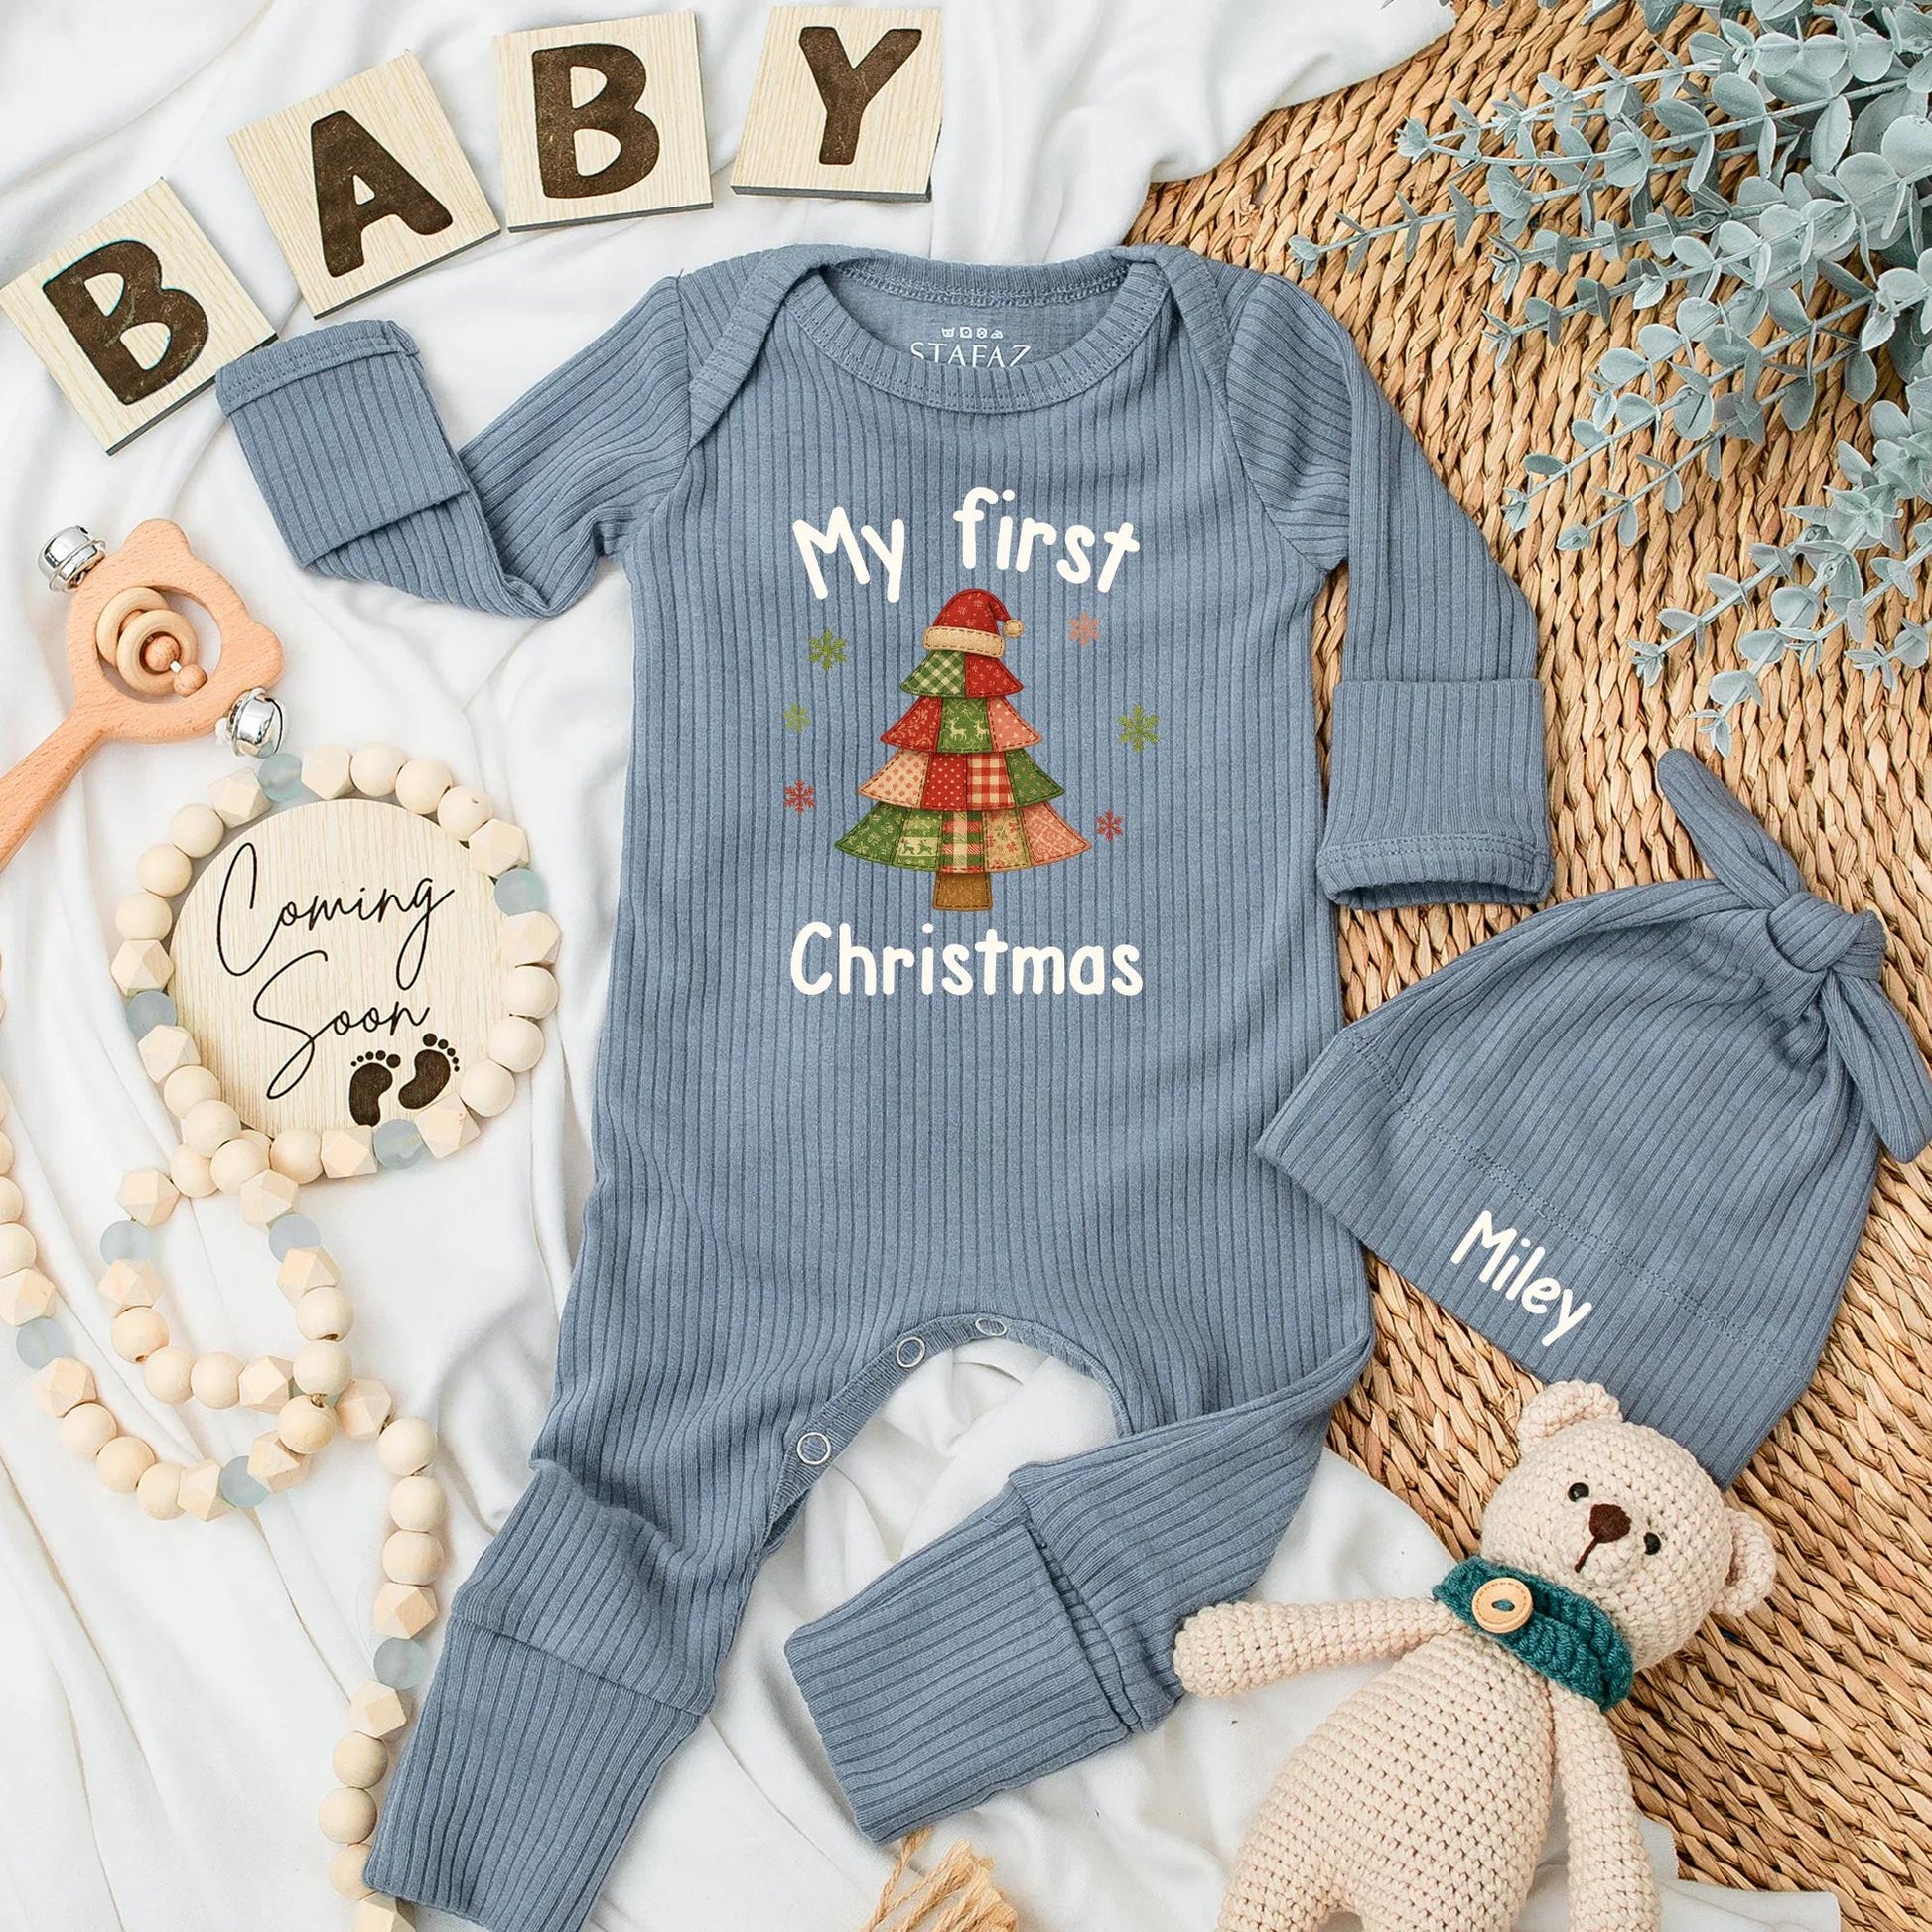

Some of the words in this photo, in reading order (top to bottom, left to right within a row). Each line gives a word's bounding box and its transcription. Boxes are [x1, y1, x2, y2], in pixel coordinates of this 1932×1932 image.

[42, 27, 923, 406] BABY
[910, 341, 1032, 368] STAFAZ
[792, 506, 905, 603] My
[952, 486, 1141, 593] first
[216, 842, 456, 991] Coming
[790, 921, 1144, 996] Christmas
[252, 949, 431, 1100] Soon
[1450, 1210, 1592, 1347] Miley
